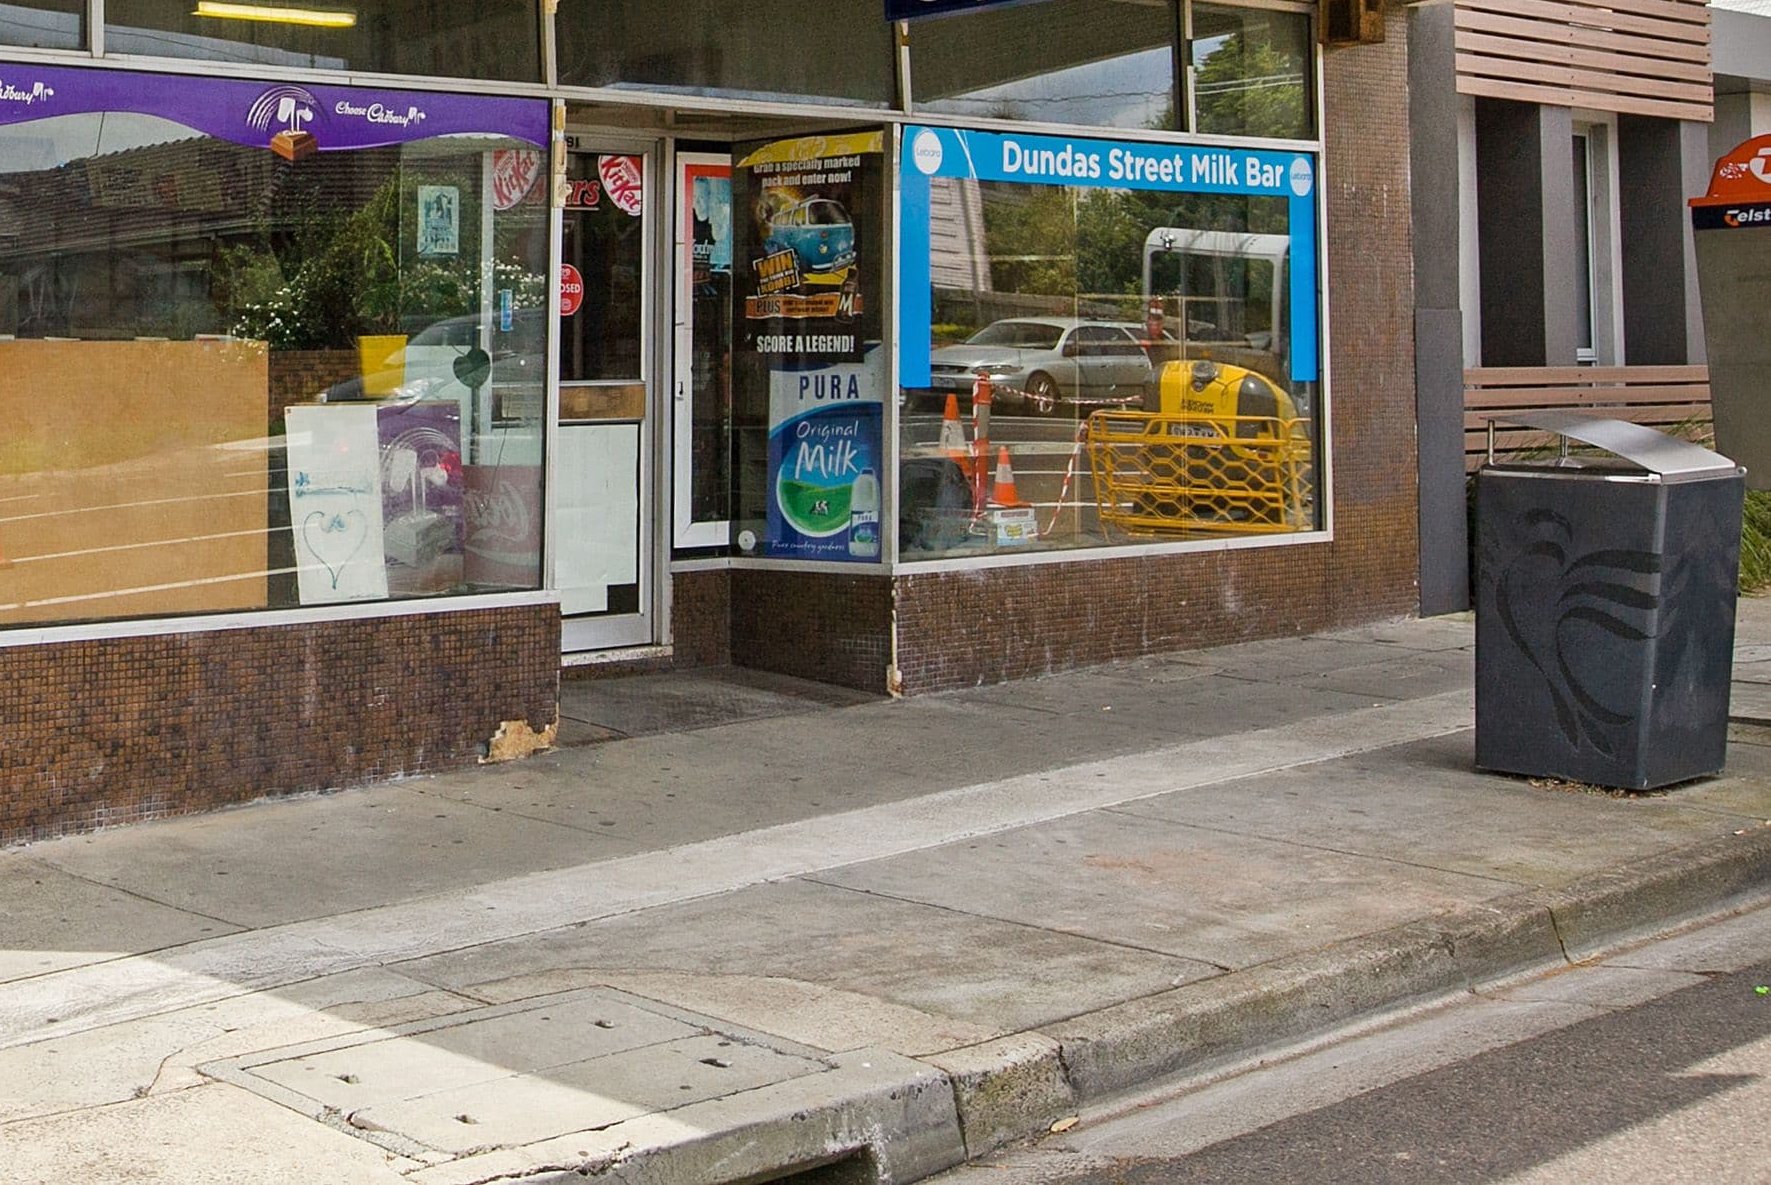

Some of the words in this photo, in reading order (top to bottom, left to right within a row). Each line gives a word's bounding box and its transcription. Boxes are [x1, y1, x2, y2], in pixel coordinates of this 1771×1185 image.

[334, 100, 368, 115] Choose
[366, 102, 409, 128] Cadbury
[781, 158, 823, 171] specially
[823, 155, 861, 169] marked
[1002, 140, 1101, 179] Dundas
[1108, 148, 1184, 184] Street
[1191, 153, 1239, 186] Milk
[1245, 156, 1284, 188] Bar
[601, 155, 643, 211] KitKat
[761, 176, 783, 188] pack
[783, 173, 801, 186] and
[801, 173, 827, 185] enter
[827, 170, 852, 184] now!
[758, 252, 794, 279] WIN
[560, 283, 581, 294] OSED
[756, 300, 781, 313] PLUS
[756, 335, 793, 353] SCORE
[794, 335, 804, 353] A
[805, 335, 855, 353] LEGEND!
[798, 373, 860, 400] PURA
[796, 419, 859, 443] Original
[794, 438, 859, 480] Milk
